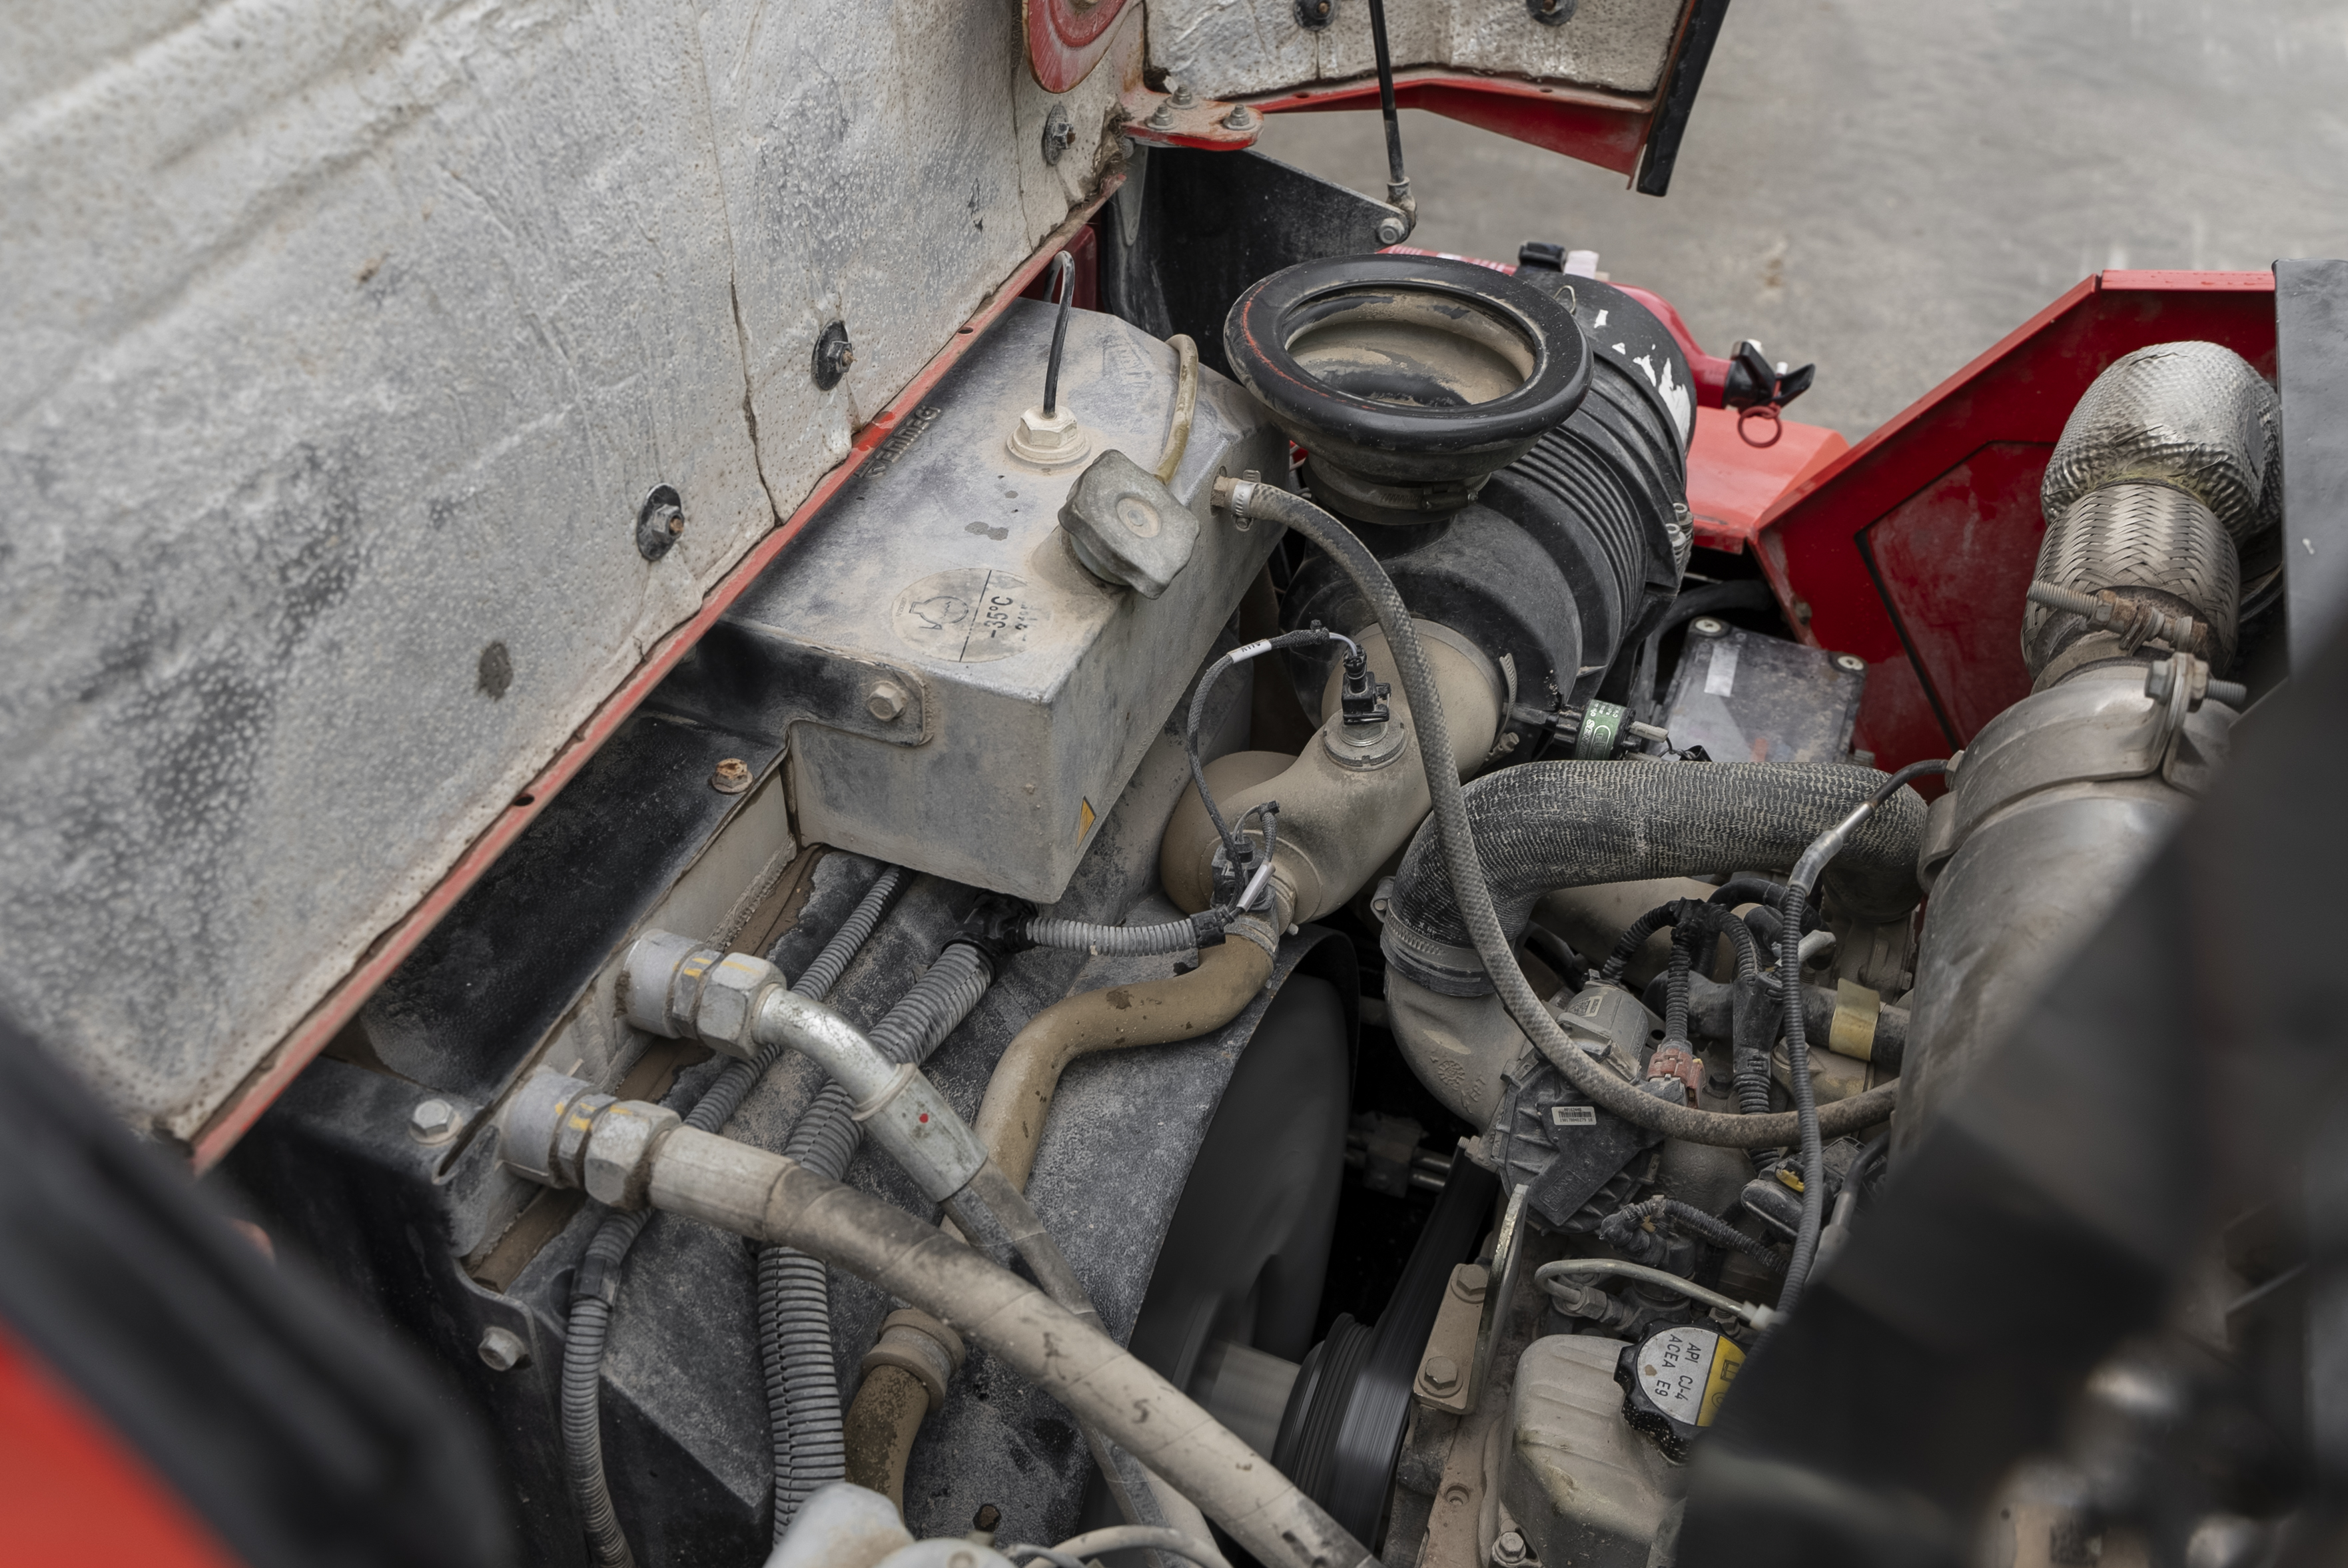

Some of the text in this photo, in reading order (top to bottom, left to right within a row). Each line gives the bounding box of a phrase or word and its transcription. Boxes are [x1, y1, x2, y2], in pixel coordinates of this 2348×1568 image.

[1469, 1076, 1486, 1102] FPT
[1655, 1334, 1683, 1397] ACEA E9
[1674, 1342, 1702, 1401] API CJ-4
